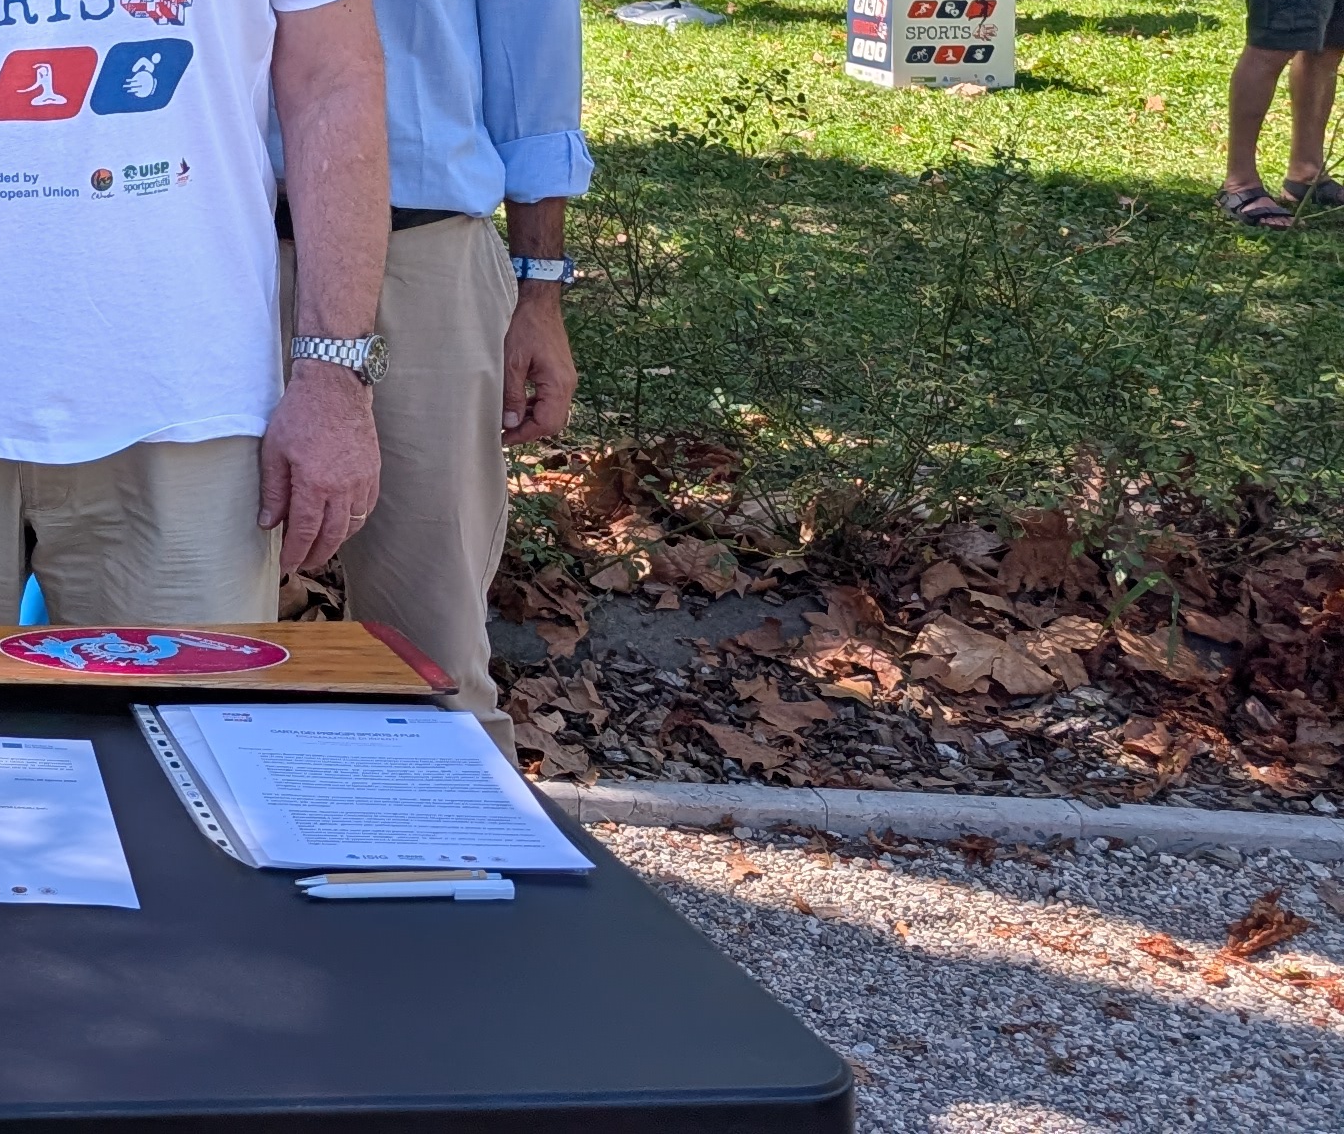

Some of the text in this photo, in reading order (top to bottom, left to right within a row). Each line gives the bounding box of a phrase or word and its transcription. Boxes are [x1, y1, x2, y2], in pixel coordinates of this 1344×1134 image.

[905, 25, 972, 41] SPORTS
[138, 161, 170, 178] UISP
[22, 171, 39, 188] by
[40, 185, 80, 199] Union
